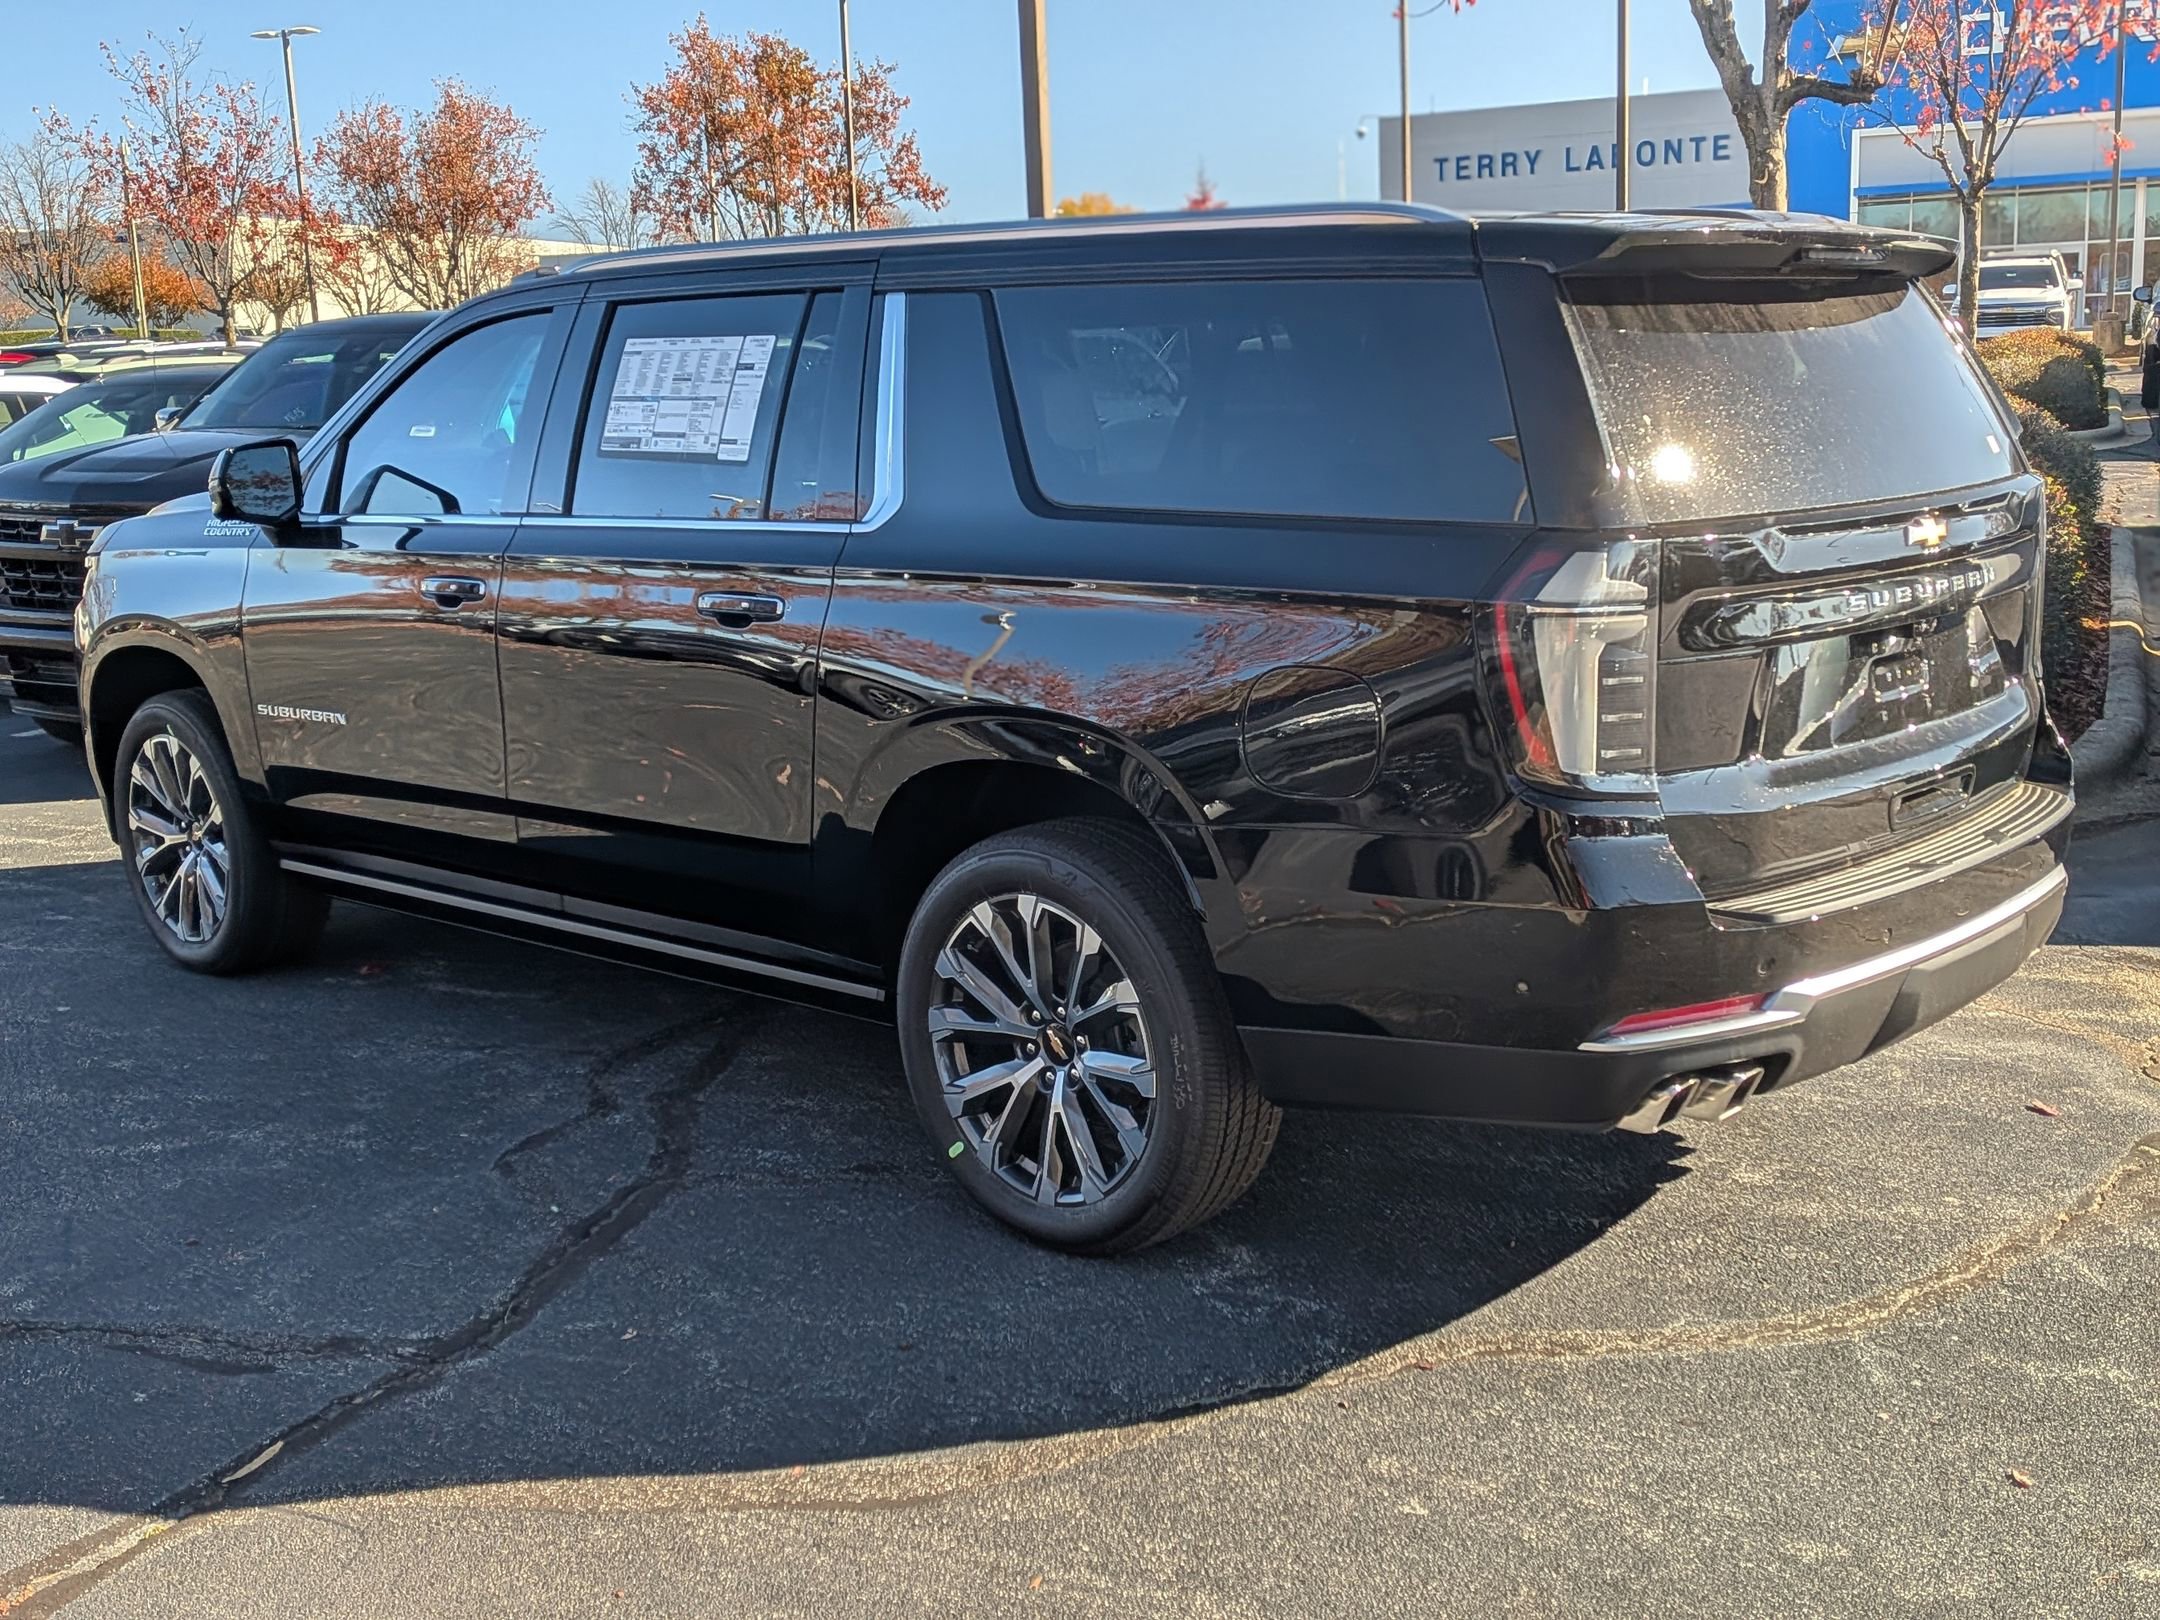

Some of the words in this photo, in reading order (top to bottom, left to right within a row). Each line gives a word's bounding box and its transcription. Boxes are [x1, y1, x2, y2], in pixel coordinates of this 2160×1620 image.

[1960, 0, 2160, 55] CHEVR
[1433, 149, 1543, 182] TERRY
[203, 527, 253, 536] COUNTRY
[1847, 566, 1996, 612] SUBURBAN
[257, 703, 347, 726] SUBURBAN
